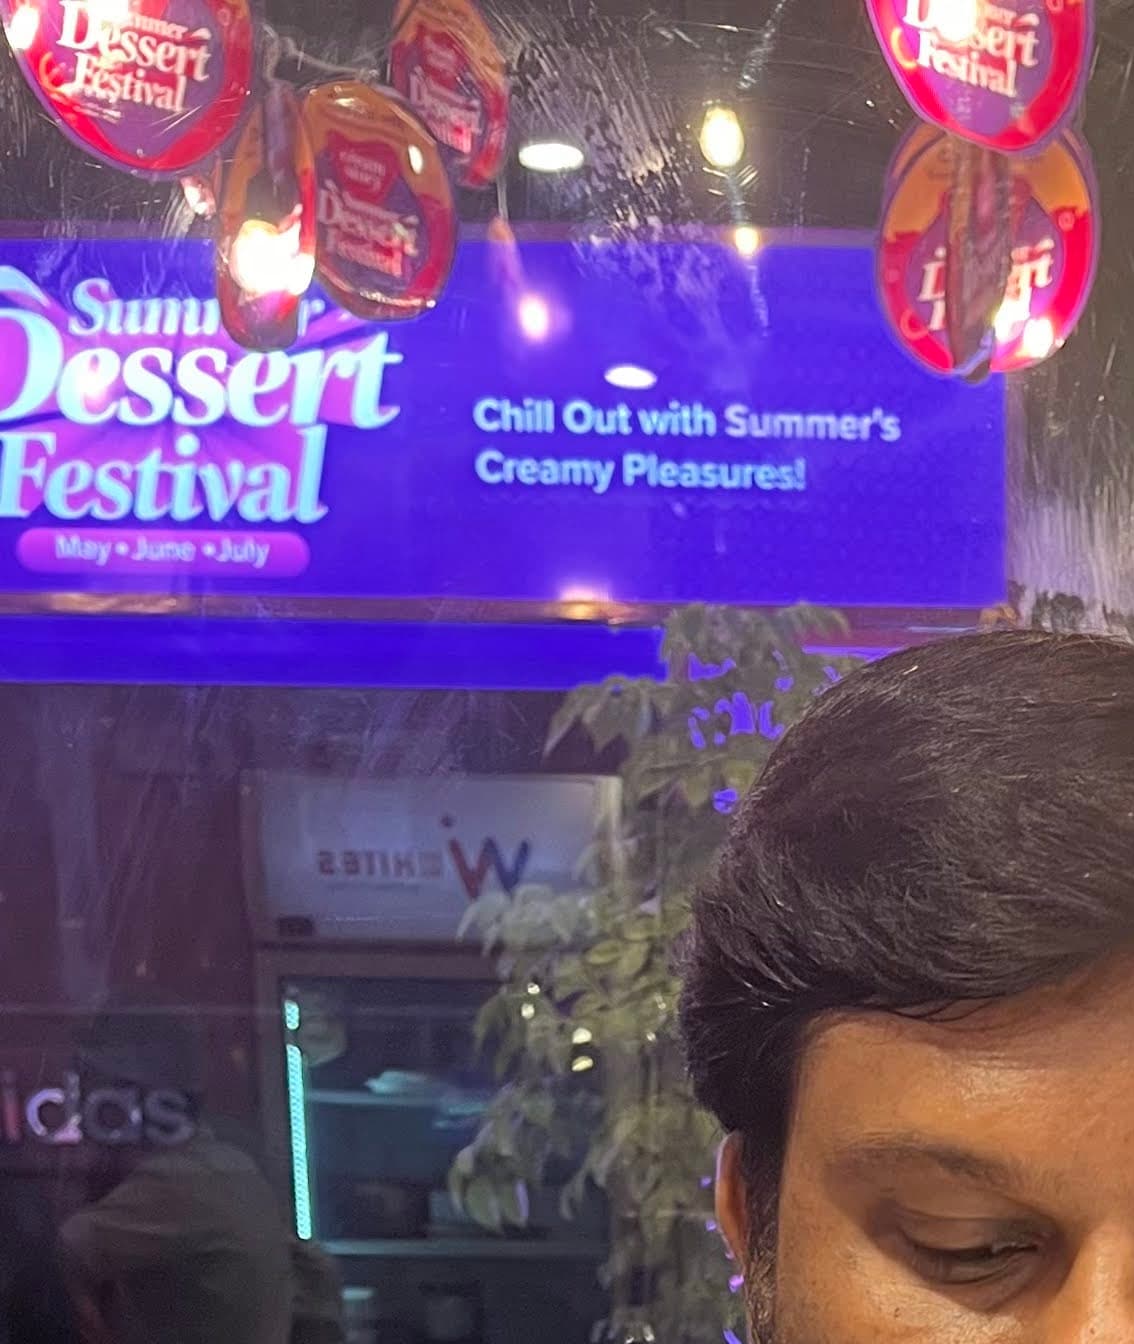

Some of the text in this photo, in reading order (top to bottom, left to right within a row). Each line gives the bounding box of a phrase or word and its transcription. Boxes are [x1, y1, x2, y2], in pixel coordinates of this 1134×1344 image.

[56, 0, 211, 82] Dessert
[68, 51, 187, 113] Festival
[0, 308, 403, 430] Dessert
[472, 398, 902, 443] Chill Out with Summer's
[0, 424, 329, 524] Festival
[474, 449, 807, 494] Creamy Pleasures!
[54, 535, 270, 569] May June July
